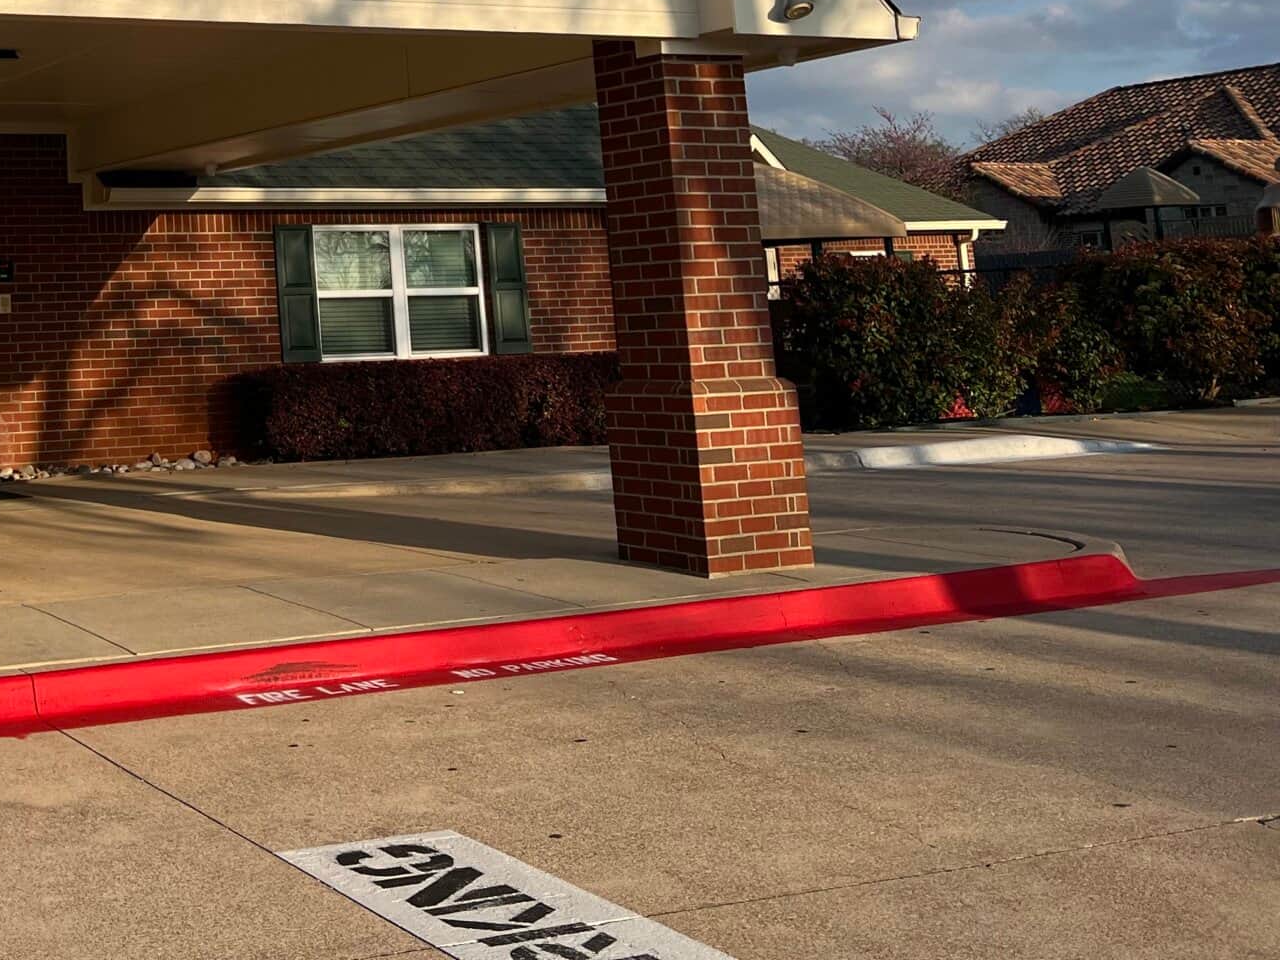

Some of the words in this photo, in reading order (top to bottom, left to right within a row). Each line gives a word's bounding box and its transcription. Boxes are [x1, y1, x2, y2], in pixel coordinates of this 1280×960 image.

[236, 689, 312, 706] FIRE
[317, 678, 400, 696] LANE
[451, 668, 497, 679] NO
[500, 653, 619, 673] PARKING
